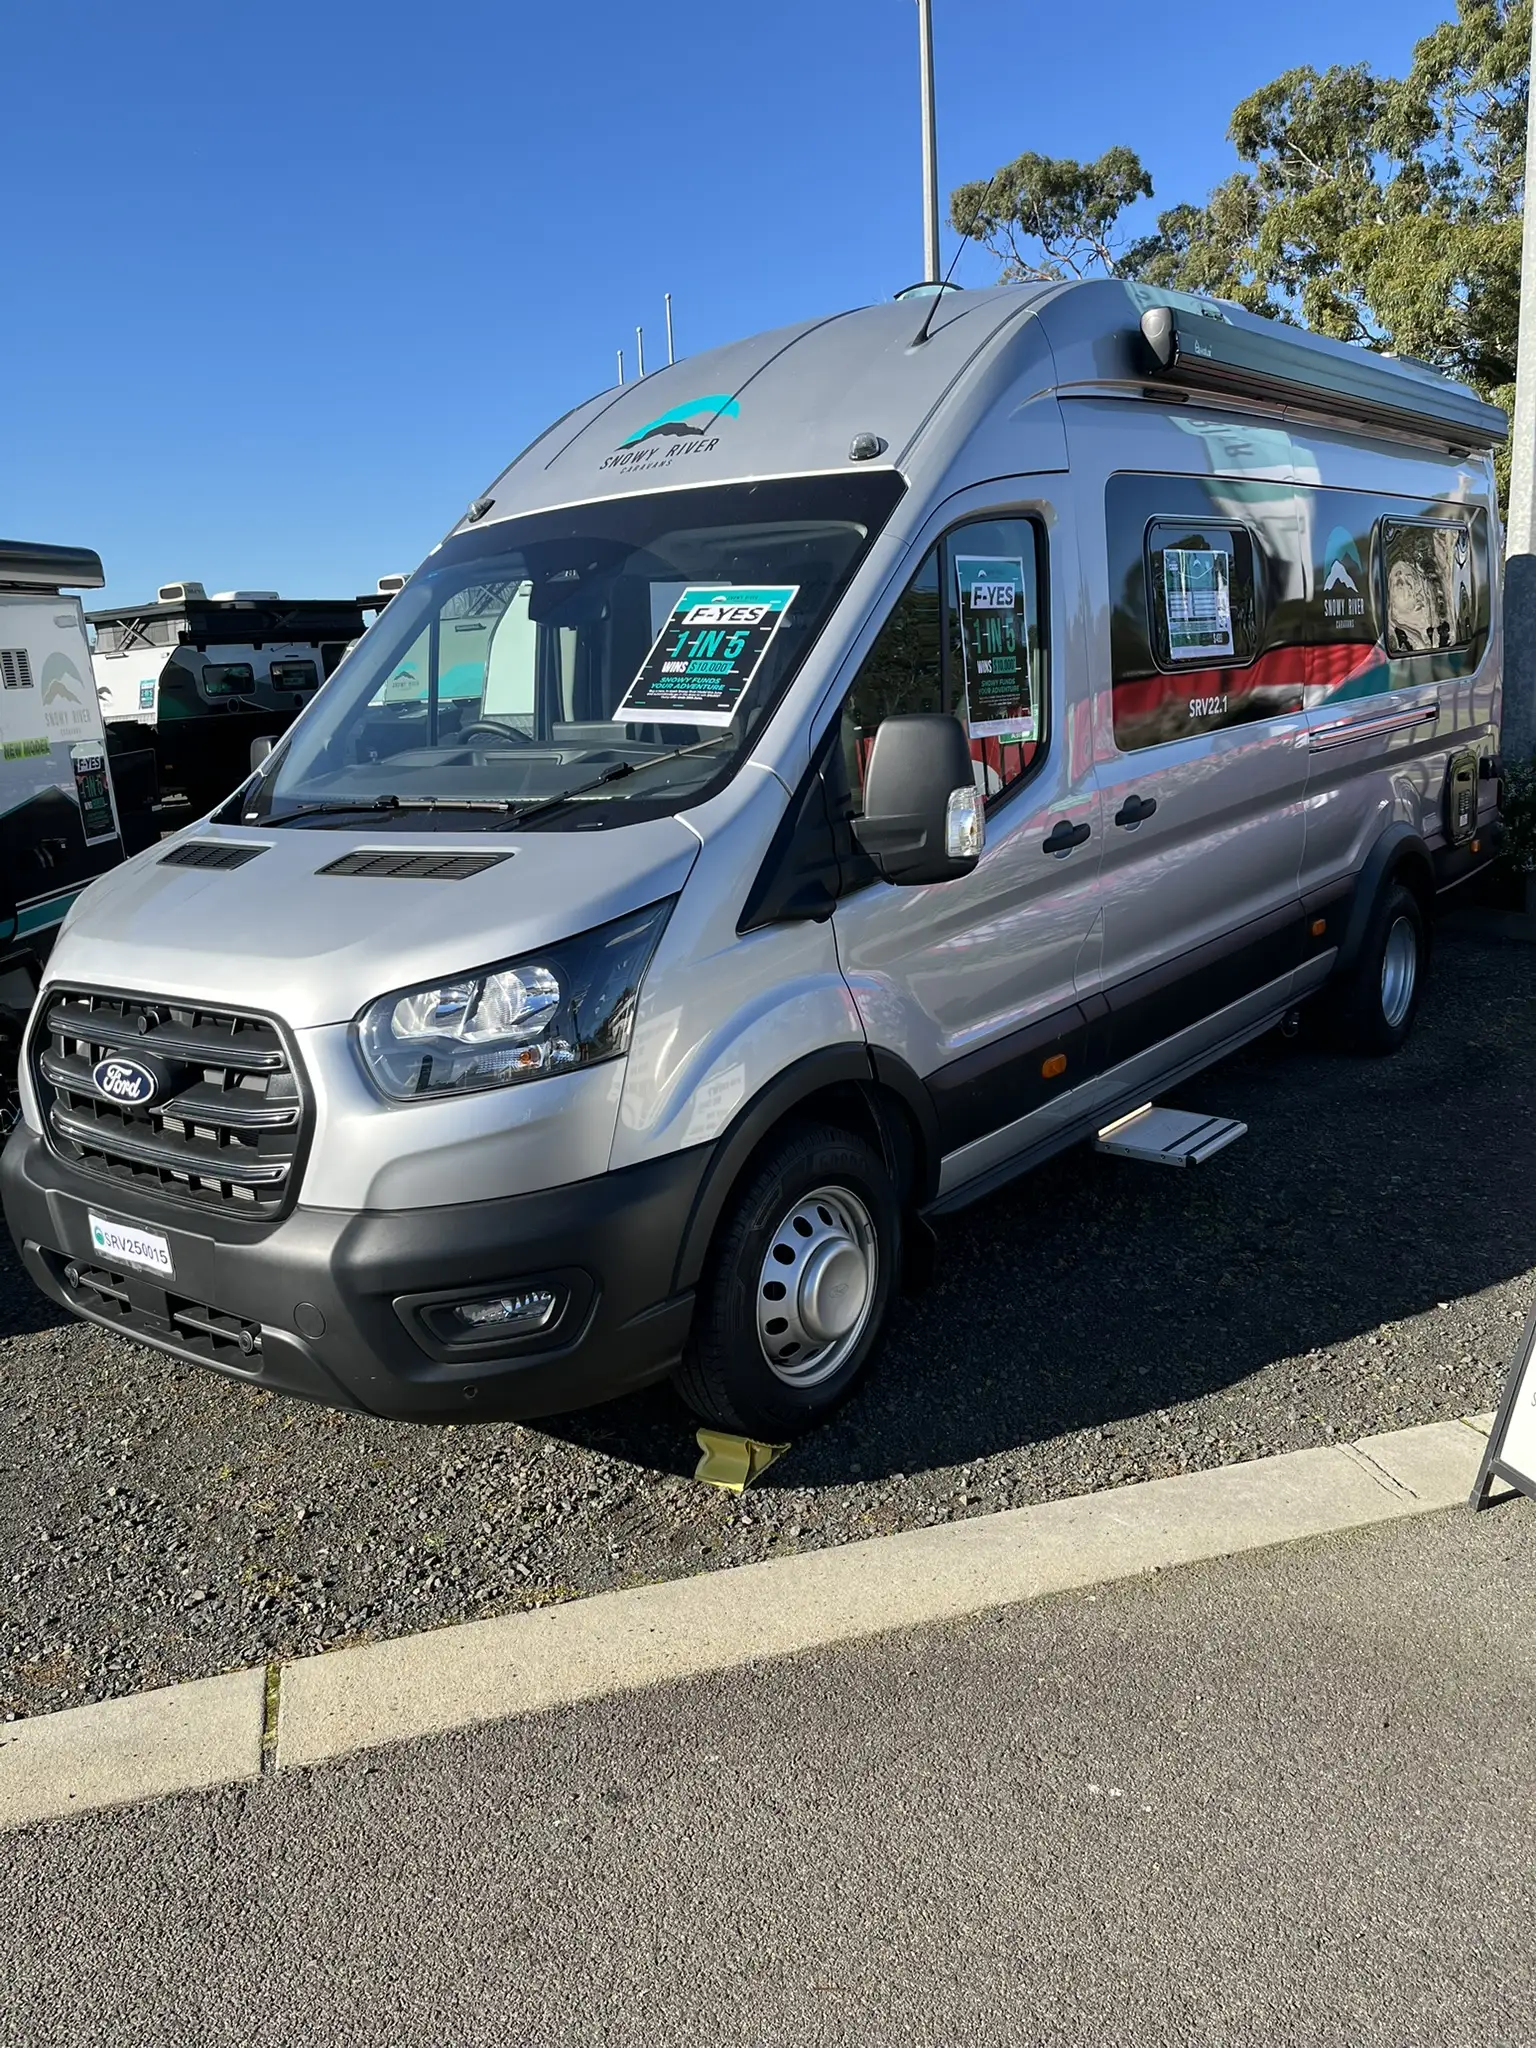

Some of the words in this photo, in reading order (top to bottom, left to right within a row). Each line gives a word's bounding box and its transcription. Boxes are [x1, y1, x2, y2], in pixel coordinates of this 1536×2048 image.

[599, 447, 660, 470] SNOWY
[665, 438, 720, 458] RIVER
[620, 459, 673, 475] CARAVANS
[974, 586, 1013, 607] F-YES
[689, 607, 764, 622] F-YES
[1324, 599, 1345, 617] SNOWY
[1348, 598, 1365, 615] RIVER
[723, 630, 751, 659] 5
[1005, 617, 1016, 653] 5
[661, 661, 689, 673] WINS
[673, 683, 726, 691] ADVENTURE
[1189, 696, 1228, 718] SRV22.1
[3, 743, 21, 760] NEW
[23, 738, 51, 756] MODEL
[79, 757, 100, 770] F-YES
[103, 1064, 141, 1098] Ford
[104, 1231, 168, 1265] SRV250015
